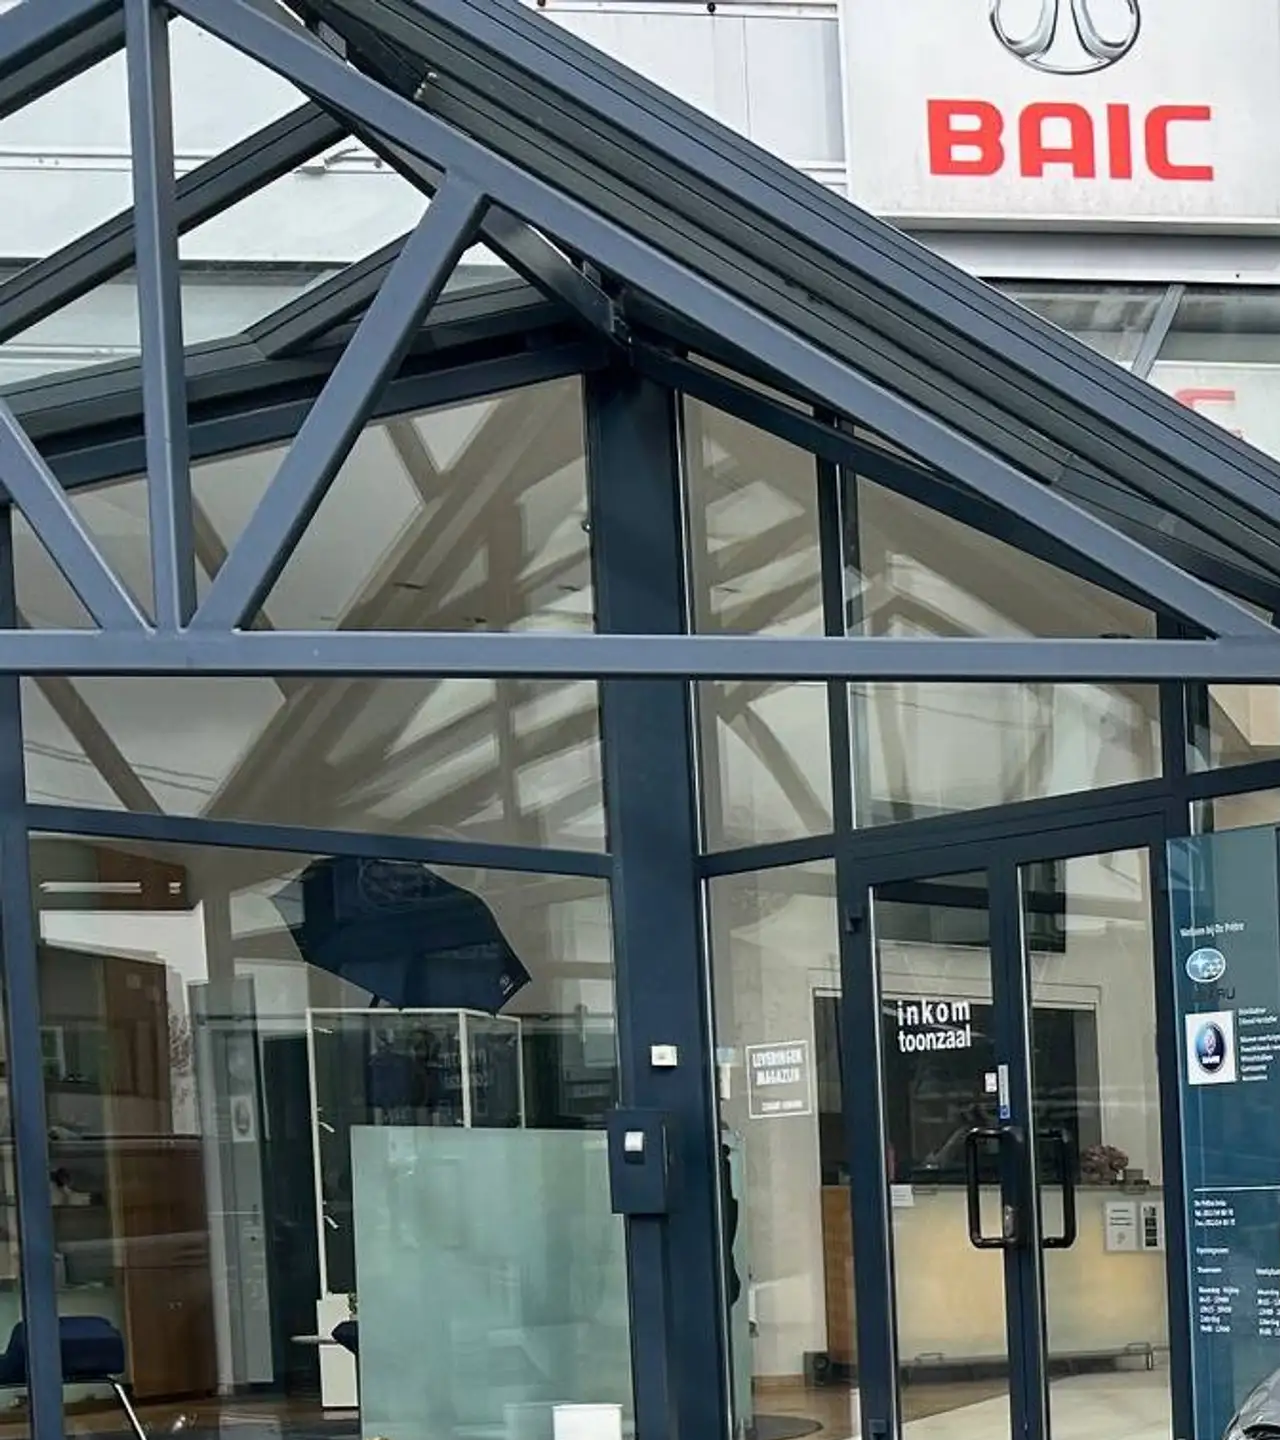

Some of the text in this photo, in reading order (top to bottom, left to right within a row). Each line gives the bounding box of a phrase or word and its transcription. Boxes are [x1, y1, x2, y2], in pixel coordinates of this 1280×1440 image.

[927, 99, 1214, 181] BAIC
[896, 1000, 972, 1026] inkom
[897, 1024, 973, 1053] toonzaal
